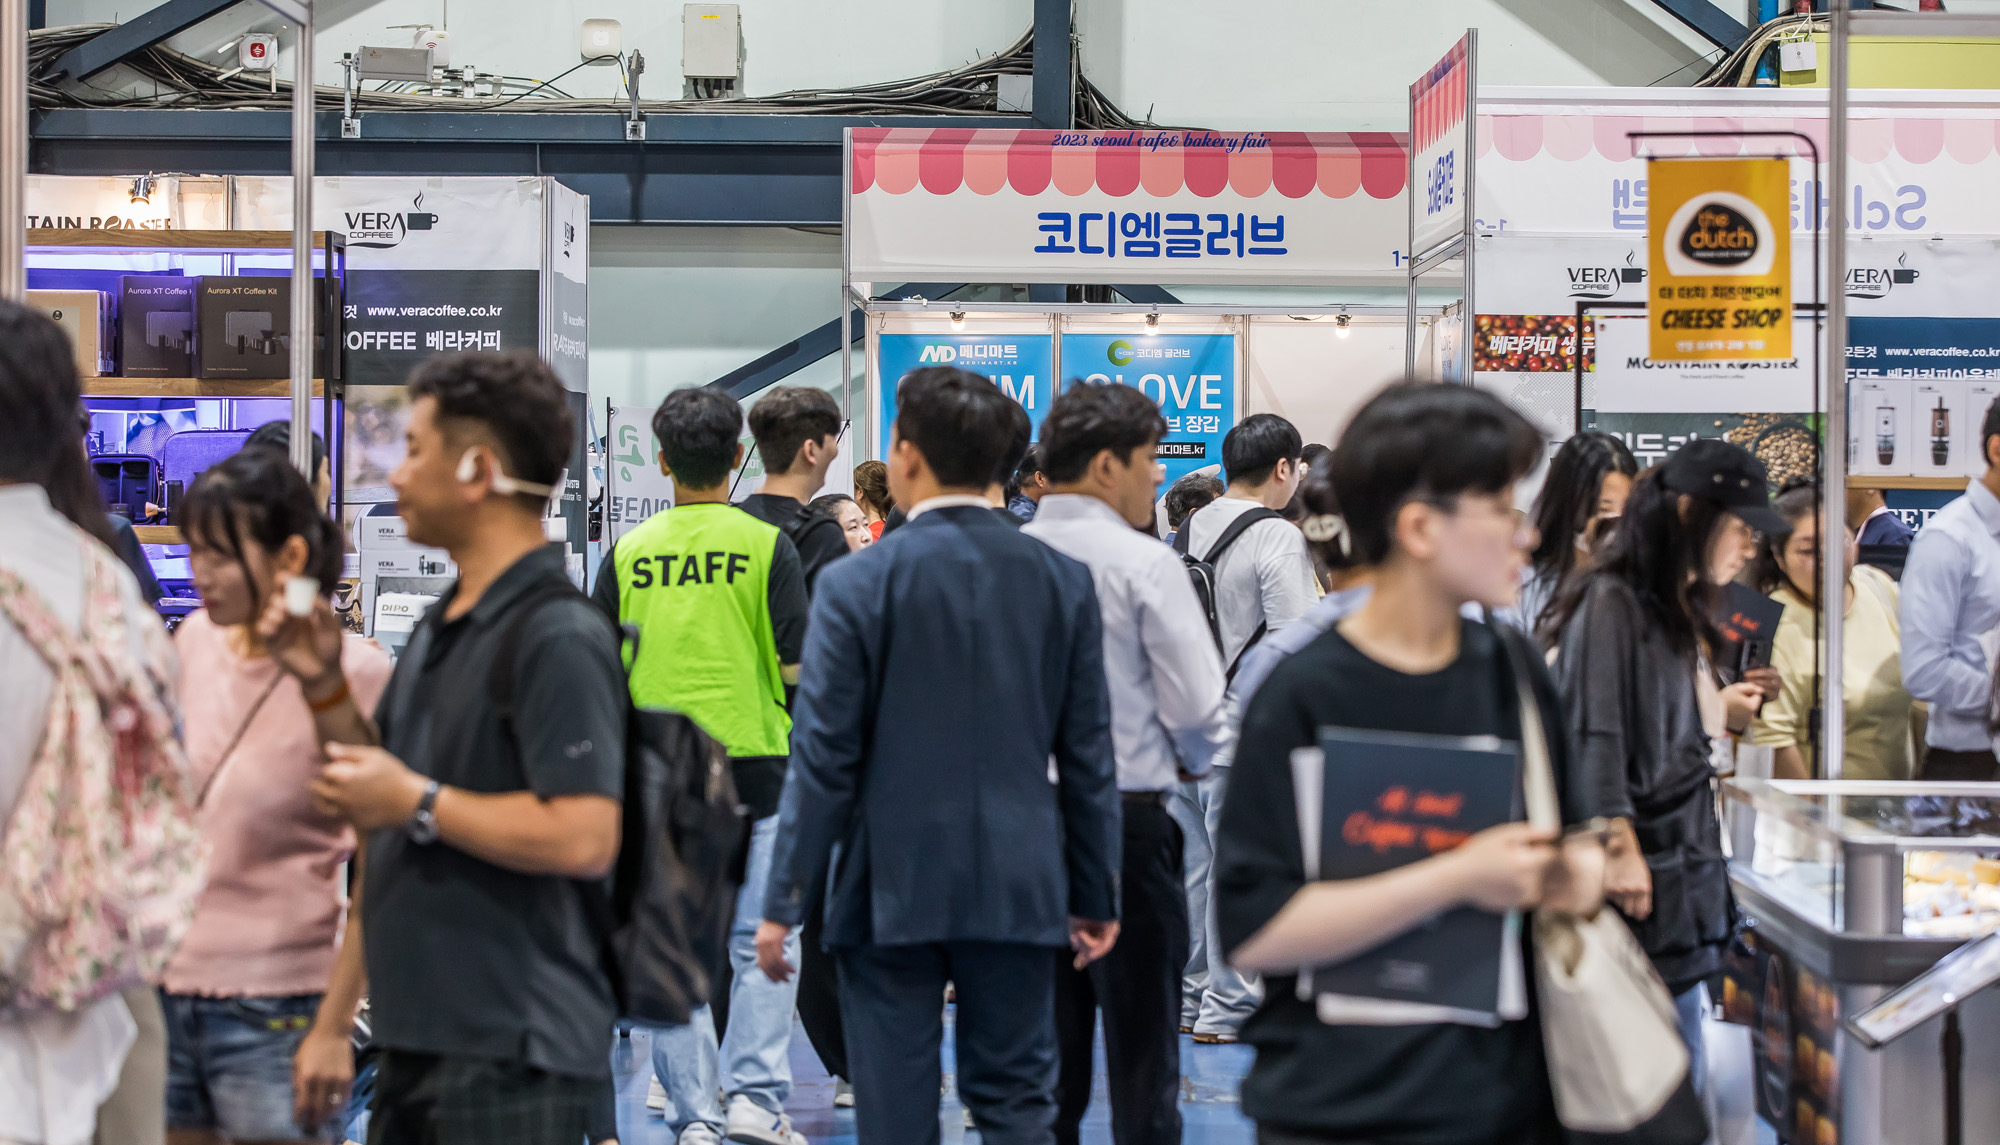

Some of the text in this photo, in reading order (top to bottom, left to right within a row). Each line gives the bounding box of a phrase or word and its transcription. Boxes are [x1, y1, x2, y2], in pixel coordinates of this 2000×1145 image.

[1051, 131, 1272, 153] 2023 seoul cafe& bakery fair
[25, 215, 81, 229] TAIN
[344, 212, 406, 231] VERA
[1698, 210, 1730, 228] the
[350, 231, 393, 239] COFFEE
[1034, 211, 1288, 259] 코디엠글러브
[1689, 226, 1754, 249] dutch
[1567, 267, 1620, 283] VERA
[128, 287, 151, 295] Aurora
[153, 287, 163, 295] XT
[165, 287, 187, 295] Coffee
[207, 287, 278, 295] Aurora XT Coffee Kit
[1571, 283, 1610, 291] COFFEE
[367, 304, 503, 317] www.veracoffee.co.kr
[1661, 308, 1782, 330] CHEESE SHOP
[343, 329, 501, 352] OFFEE 베라커피
[1489, 335, 1558, 355] 베라커피
[959, 344, 1018, 359] 메디마트
[1136, 348, 1163, 358] 코디엠
[1165, 348, 1191, 358] 글러브
[1885, 346, 2000, 358] www.veracoffee.co.kr
[1085, 373, 1222, 410] OVE
[1165, 415, 1220, 433] 브 장갑
[632, 552, 749, 589] STAFF
[381, 604, 409, 613] DIPO
